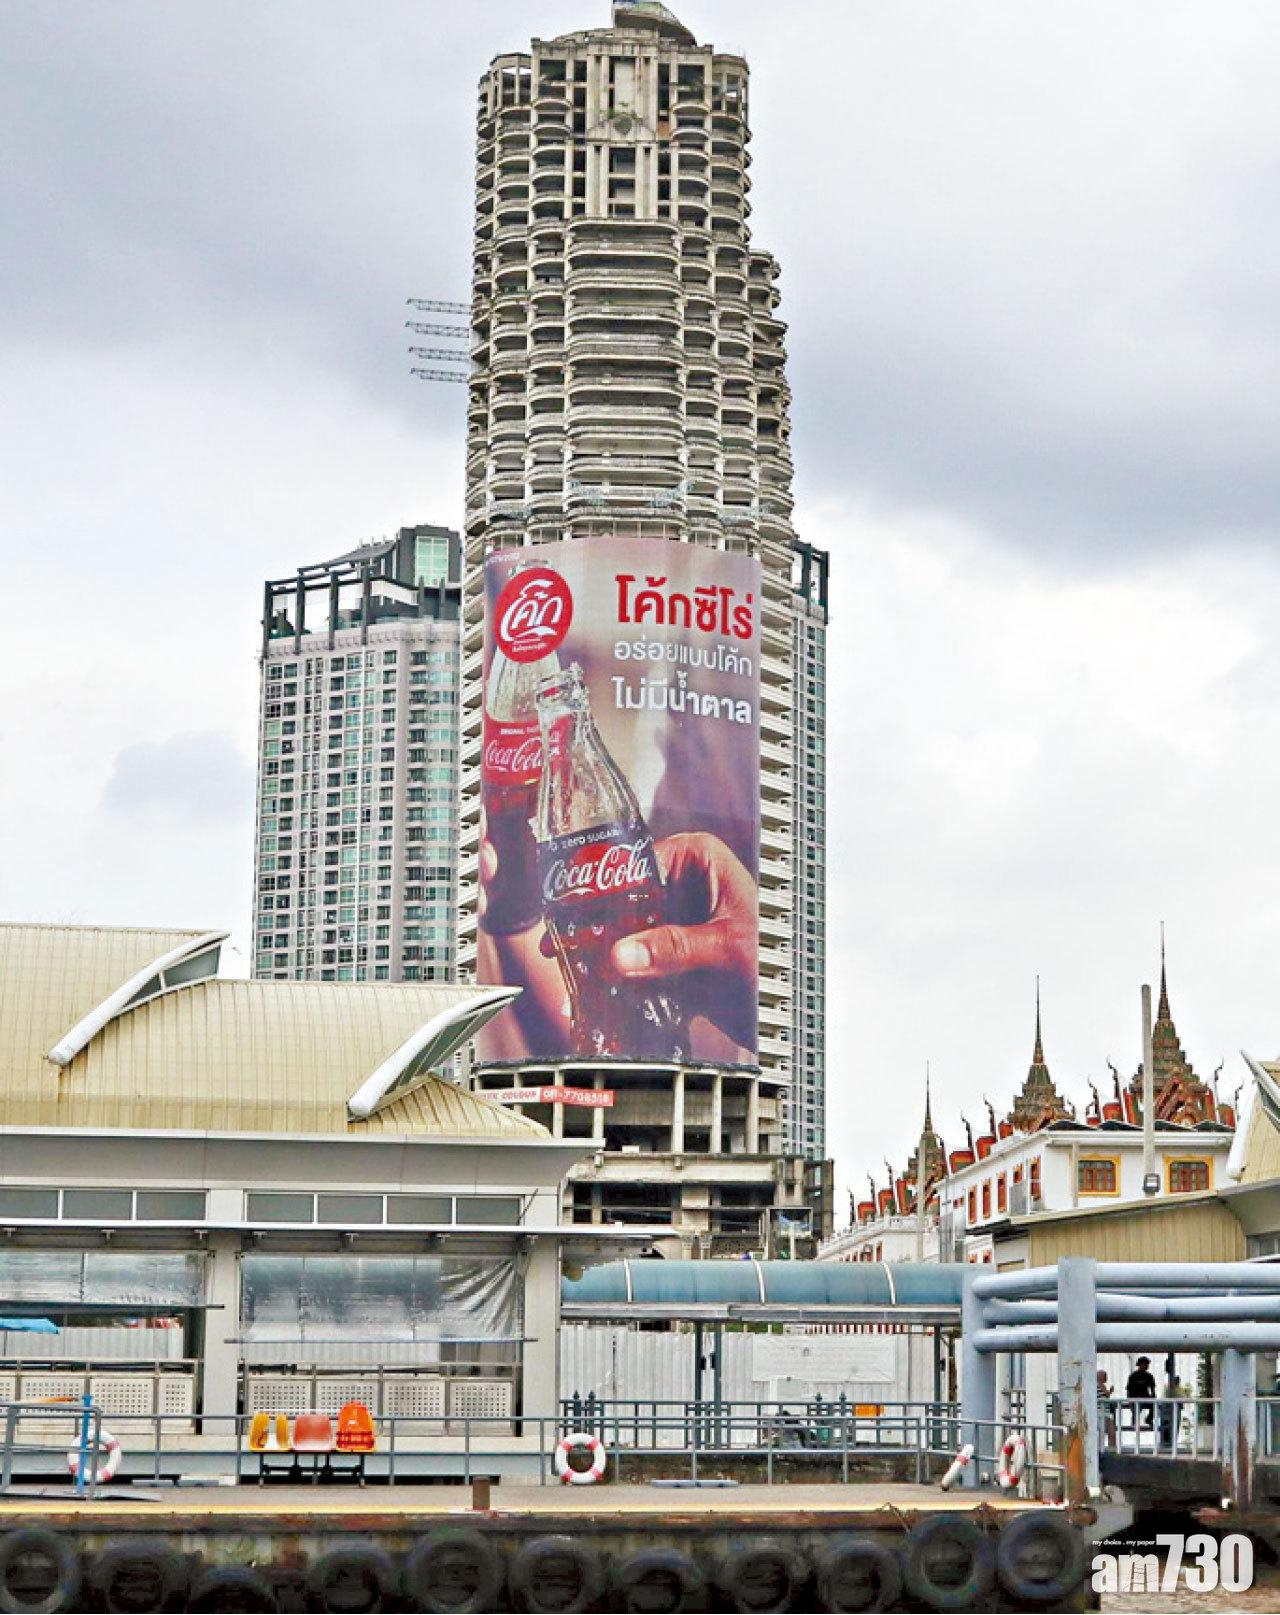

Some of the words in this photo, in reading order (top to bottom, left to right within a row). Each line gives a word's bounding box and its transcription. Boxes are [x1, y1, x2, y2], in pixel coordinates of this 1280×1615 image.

[614, 574, 753, 640] โค้กซีโร่
[613, 635, 753, 677] อร่อยแบบโค้ก
[610, 670, 753, 724] ไม่มีน้ำตาล
[543, 835, 654, 901] Coca-Cola
